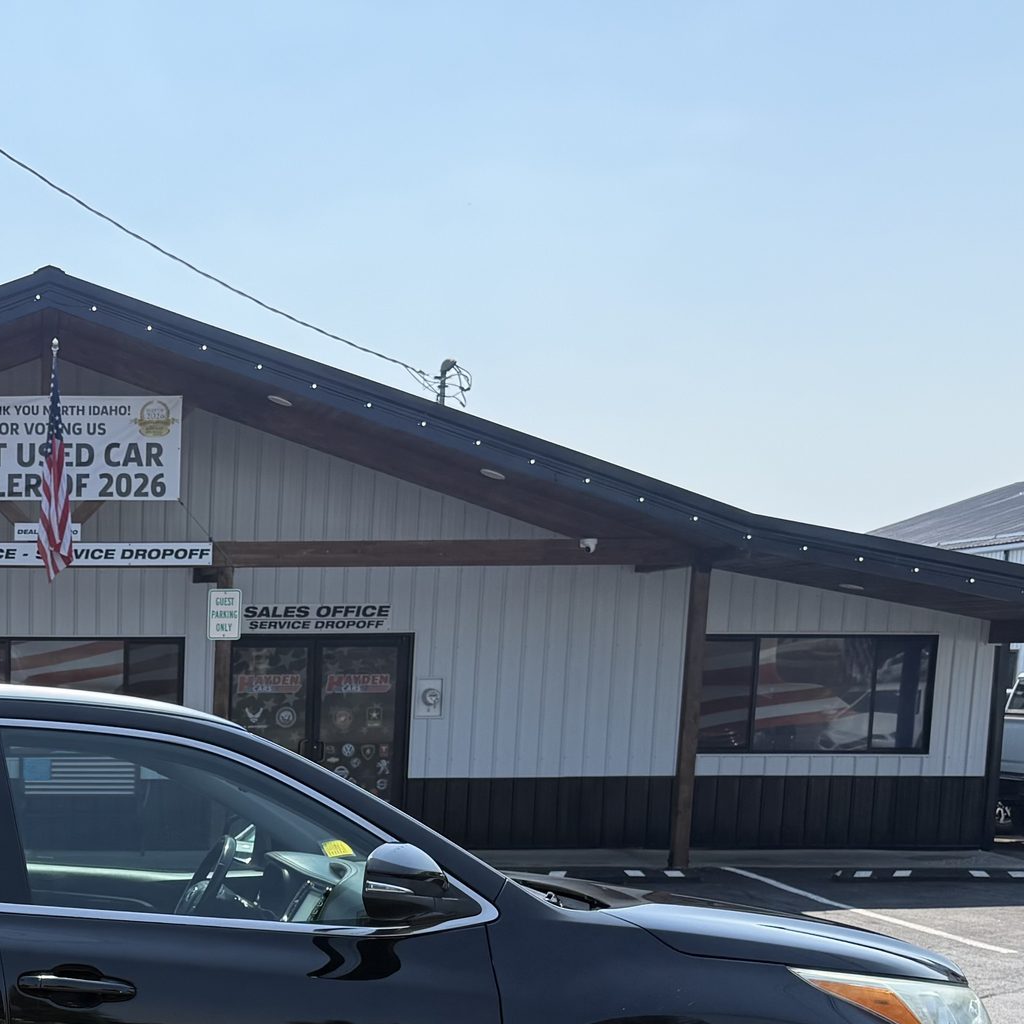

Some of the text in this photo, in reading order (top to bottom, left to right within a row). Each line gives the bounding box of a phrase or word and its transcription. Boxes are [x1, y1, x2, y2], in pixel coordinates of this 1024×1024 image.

[14, 405, 40, 416] YOU
[43, 405, 85, 416] NRTH
[88, 405, 131, 416] IDAHO!
[24, 422, 82, 435] VONG
[86, 422, 107, 435] US
[17, 442, 94, 467] UED
[104, 442, 164, 467] CAR
[98, 473, 166, 498] 2026
[36, 548, 116, 560] VICE
[120, 548, 211, 560] DROPOFF
[215, 597, 234, 606] GUEST
[211, 610, 238, 619] PARKING
[243, 605, 391, 618] SALES OFFICE
[216, 623, 232, 632] ONLY
[249, 620, 384, 630] SERVICE DROPOFF
[238, 675, 299, 691] HAYDEN
[327, 675, 389, 691] HAYDEN
